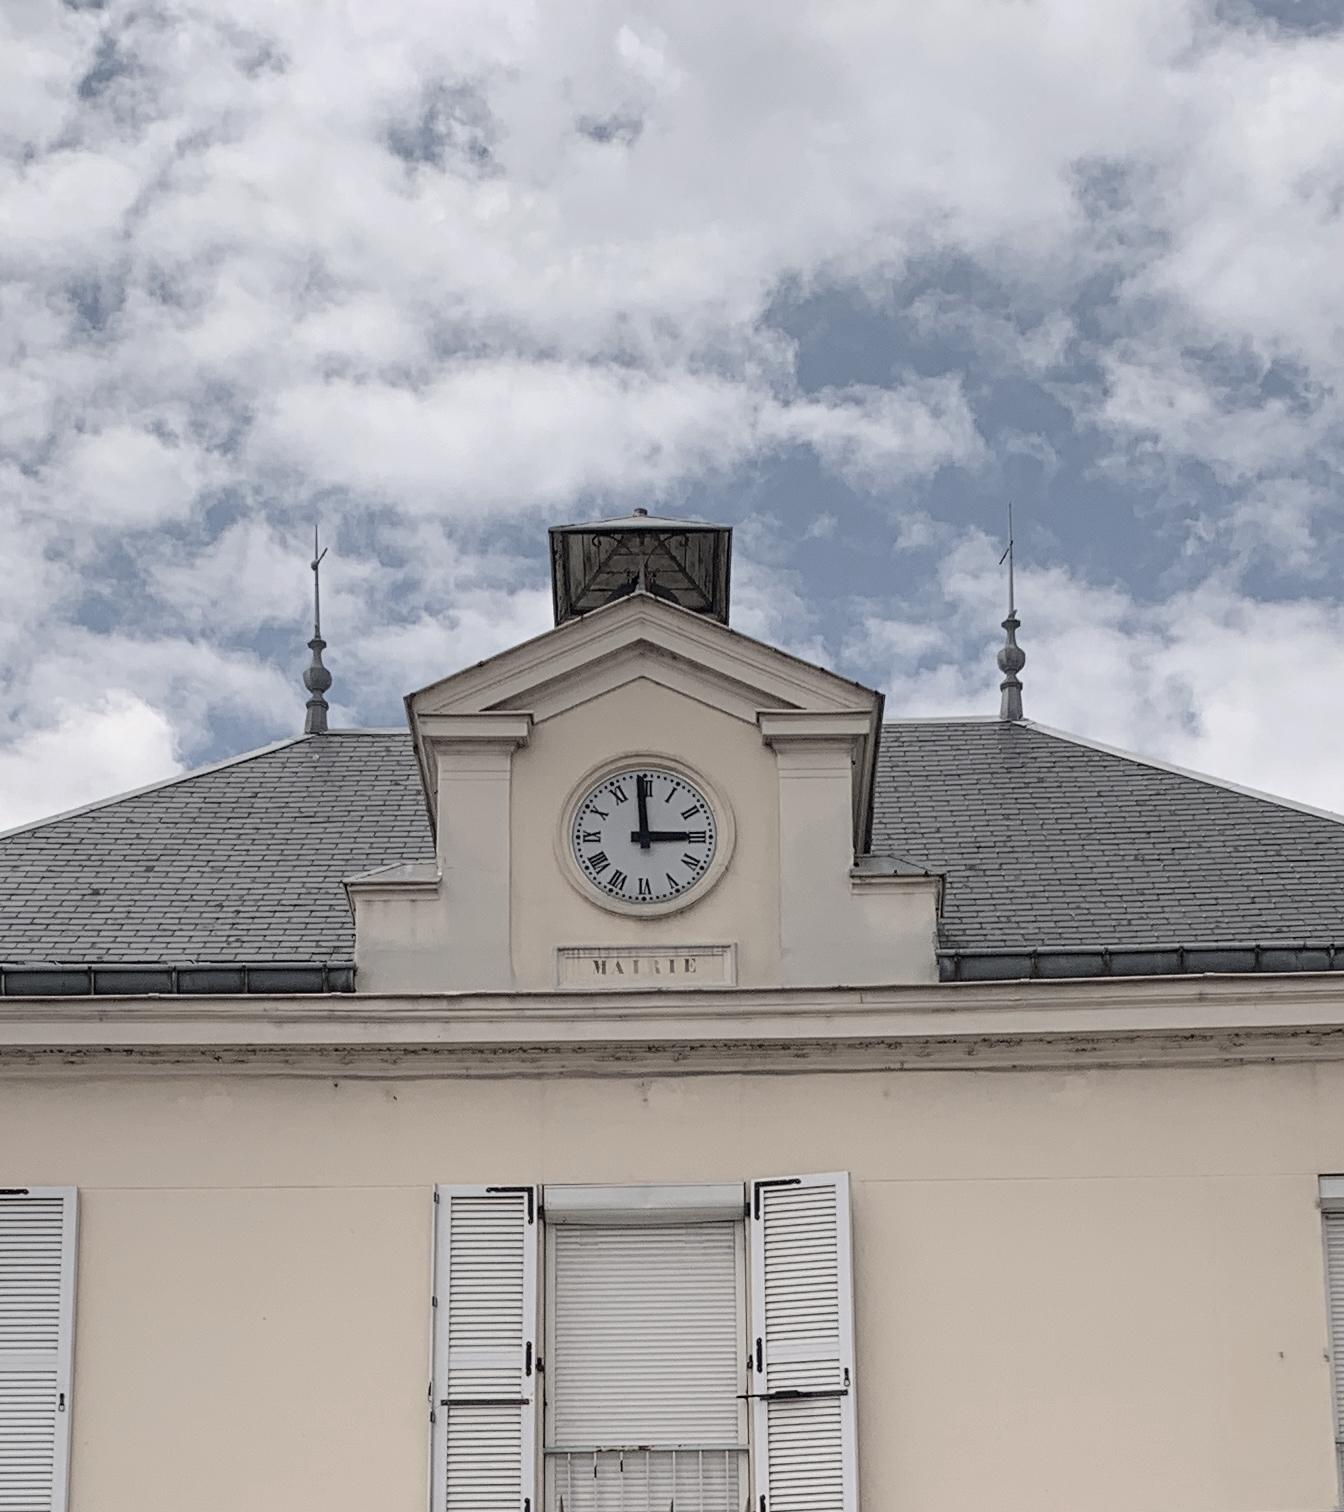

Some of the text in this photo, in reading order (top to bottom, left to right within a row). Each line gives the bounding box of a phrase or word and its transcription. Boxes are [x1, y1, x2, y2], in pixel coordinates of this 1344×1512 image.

[610, 785, 629, 805] XI
[665, 787, 677, 803] I
[590, 806, 609, 820] X
[681, 805, 700, 820] II
[587, 851, 610, 875] VIII
[681, 853, 701, 871] IV
[607, 870, 628, 891] VII
[638, 878, 652, 895] VI
[666, 873, 678, 889] V
[593, 958, 697, 975] MAIRIE
